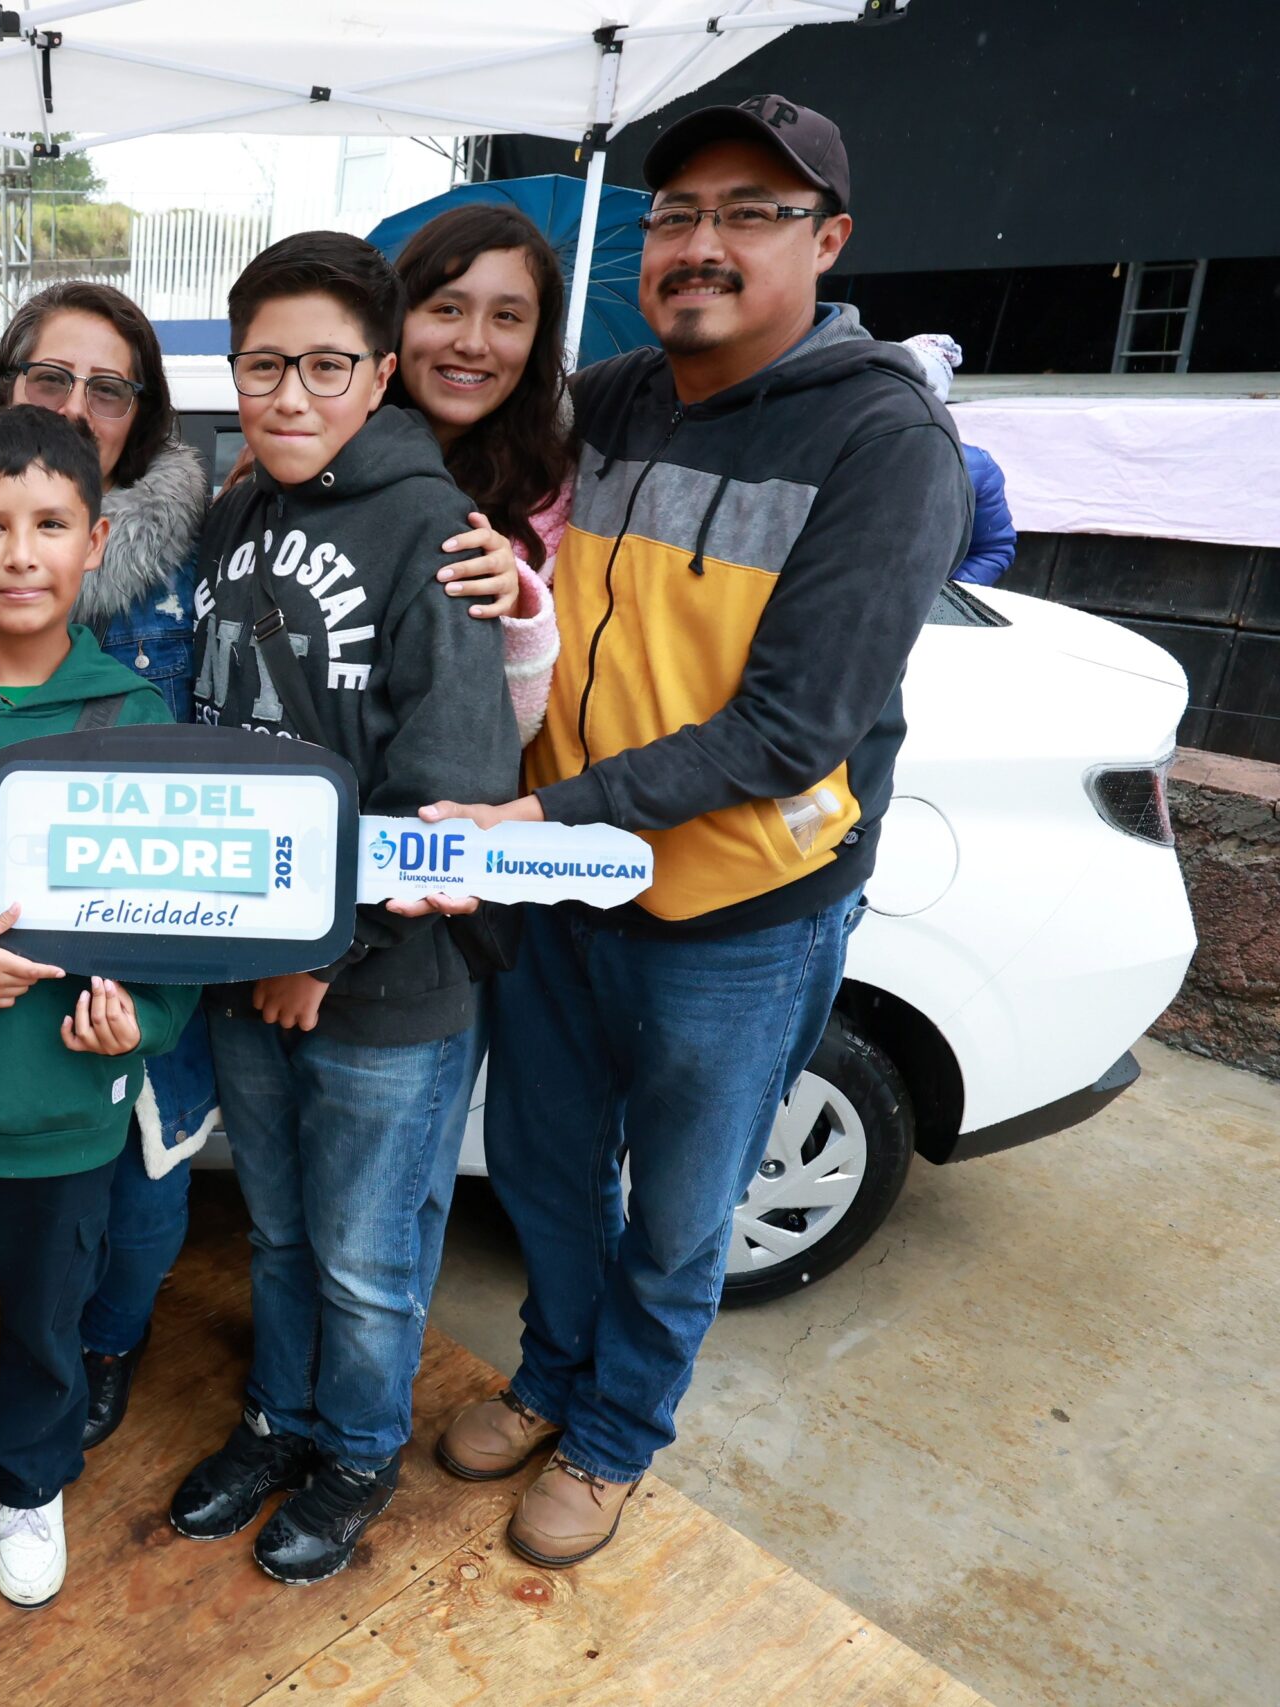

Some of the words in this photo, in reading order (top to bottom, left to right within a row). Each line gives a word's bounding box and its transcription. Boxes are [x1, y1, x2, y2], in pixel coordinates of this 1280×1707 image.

[67, 774, 149, 814] DÍA
[164, 783, 255, 817] DEL
[65, 836, 253, 879] PADRE
[275, 835, 293, 889] 2025
[399, 831, 466, 873] DIF
[486, 849, 646, 880] HUIXQUILUCAN
[399, 870, 464, 884] HUIXQUILUCAN
[75, 899, 239, 928] ¡Felicidades!
